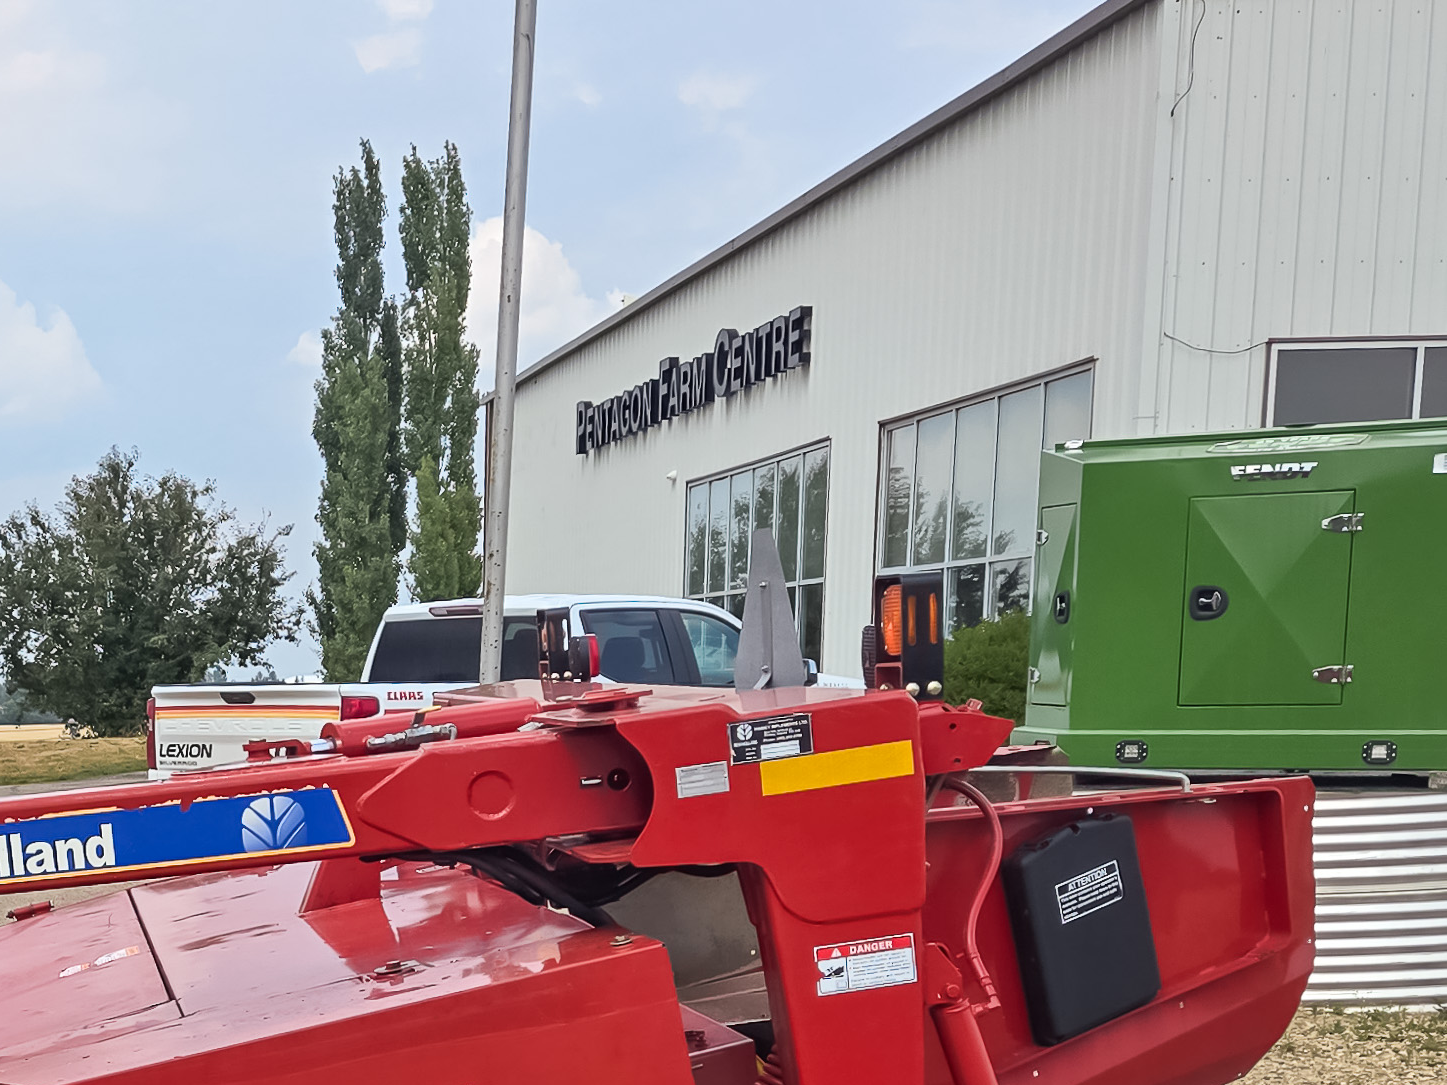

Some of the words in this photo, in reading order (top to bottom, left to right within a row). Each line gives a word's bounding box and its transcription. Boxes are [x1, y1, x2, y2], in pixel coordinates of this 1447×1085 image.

[576, 380, 658, 454] PENTAGON
[659, 357, 712, 420] FARM
[713, 306, 811, 397] CENTRE
[1230, 461, 1319, 481] FENDT
[387, 691, 424, 701] CLAAS
[160, 744, 212, 758] LEXION
[1068, 867, 1107, 891] ATTENTION
[849, 940, 893, 955] DANGER
